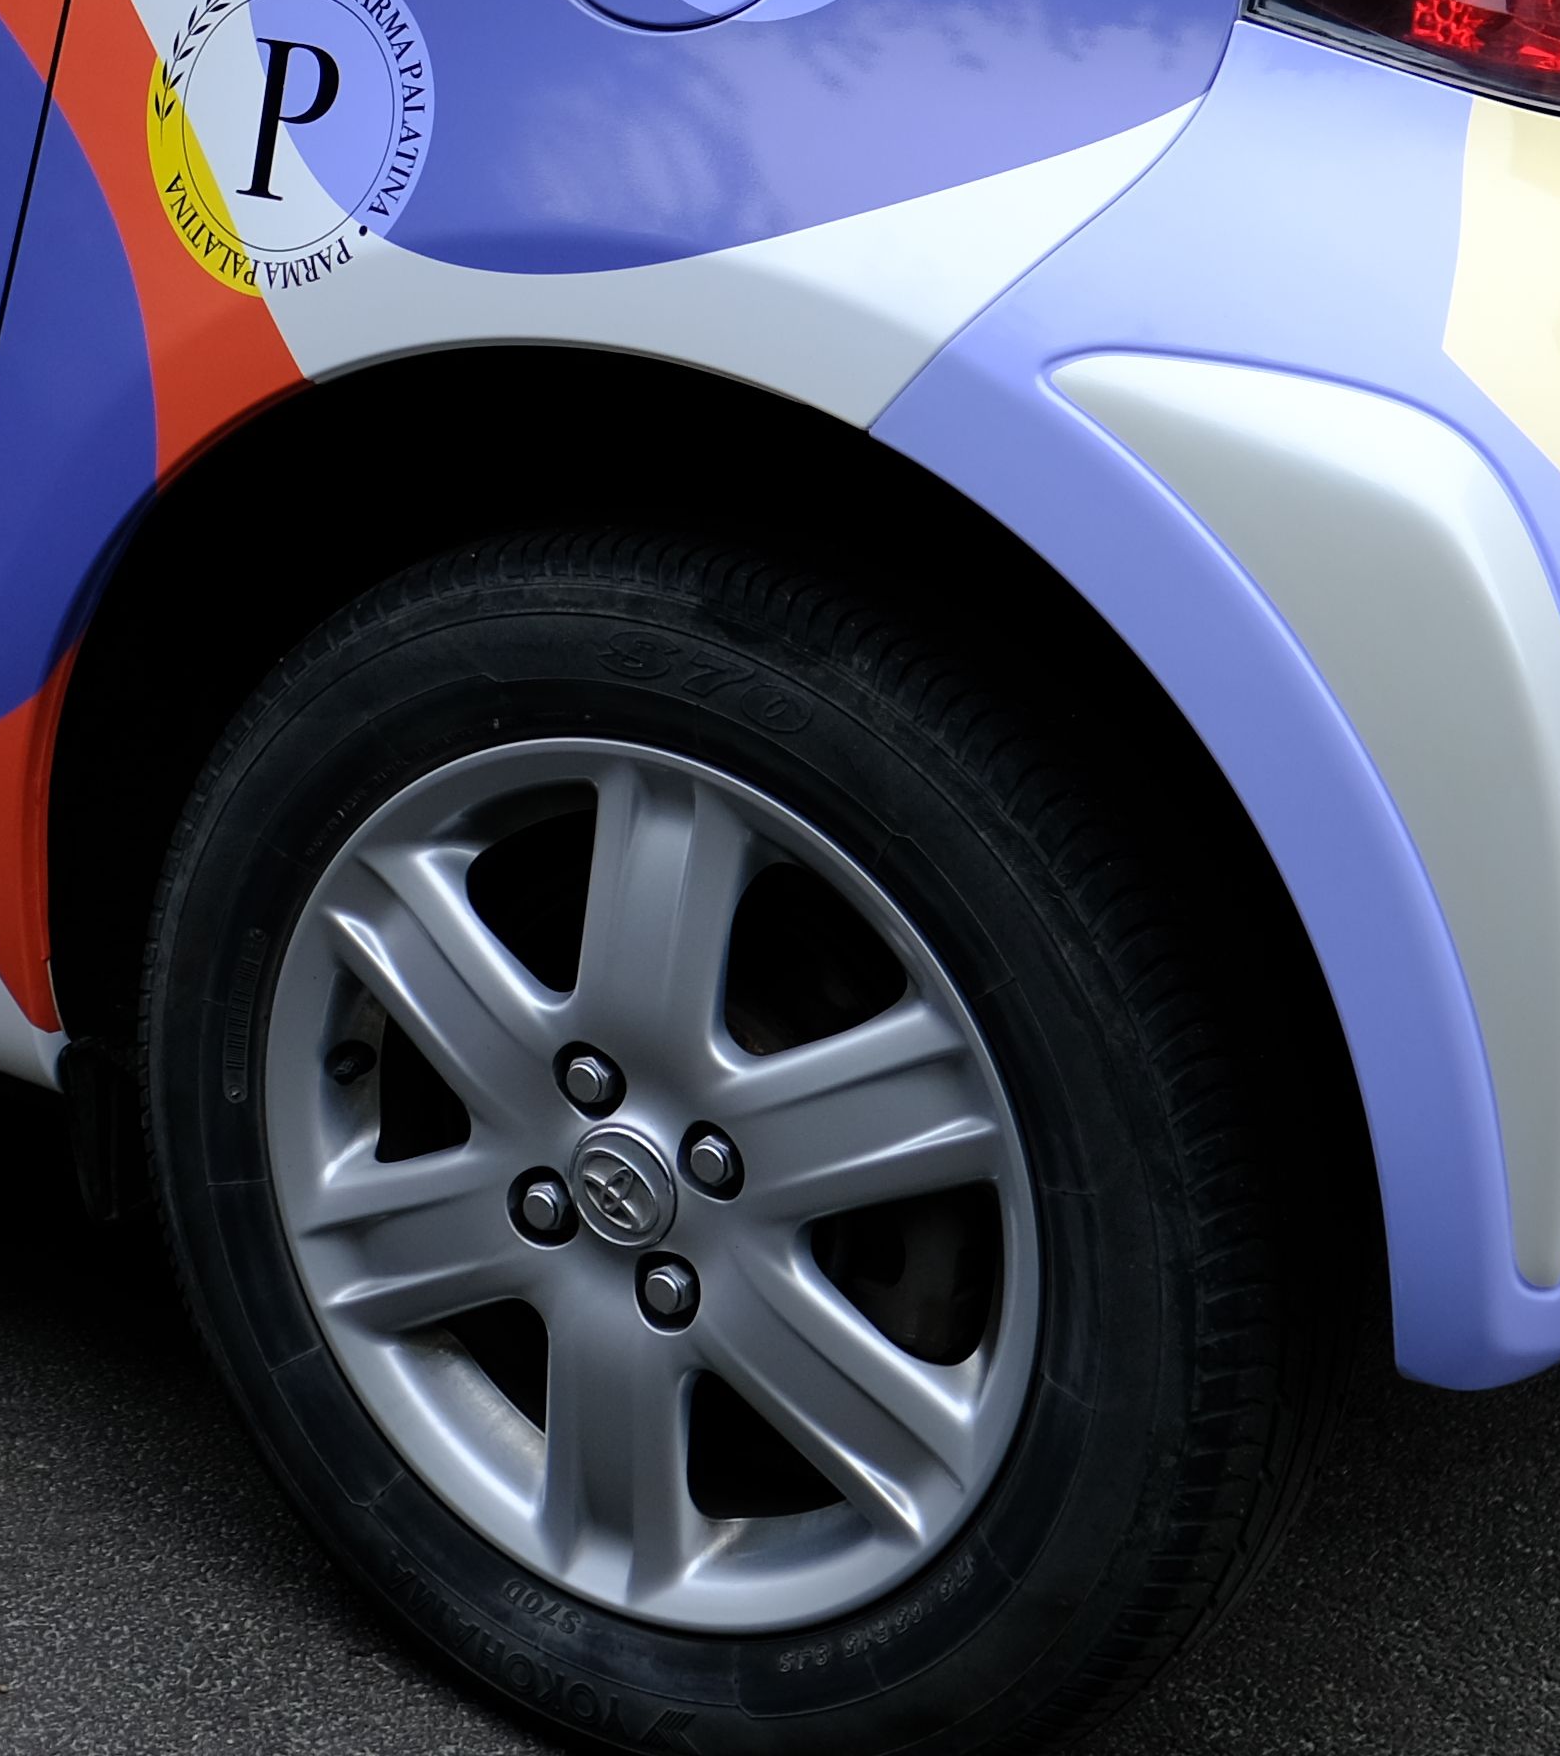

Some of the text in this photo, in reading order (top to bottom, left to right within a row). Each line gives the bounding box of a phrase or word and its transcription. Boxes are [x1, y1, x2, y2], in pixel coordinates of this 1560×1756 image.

[235, 37, 340, 201] P
[366, 59, 426, 218] PALATINA
[164, 171, 355, 290] PARMA PALATINA
[596, 629, 814, 732] S70
[383, 1552, 632, 1740] YOKOHAMA
[499, 1578, 584, 1635] S70D
